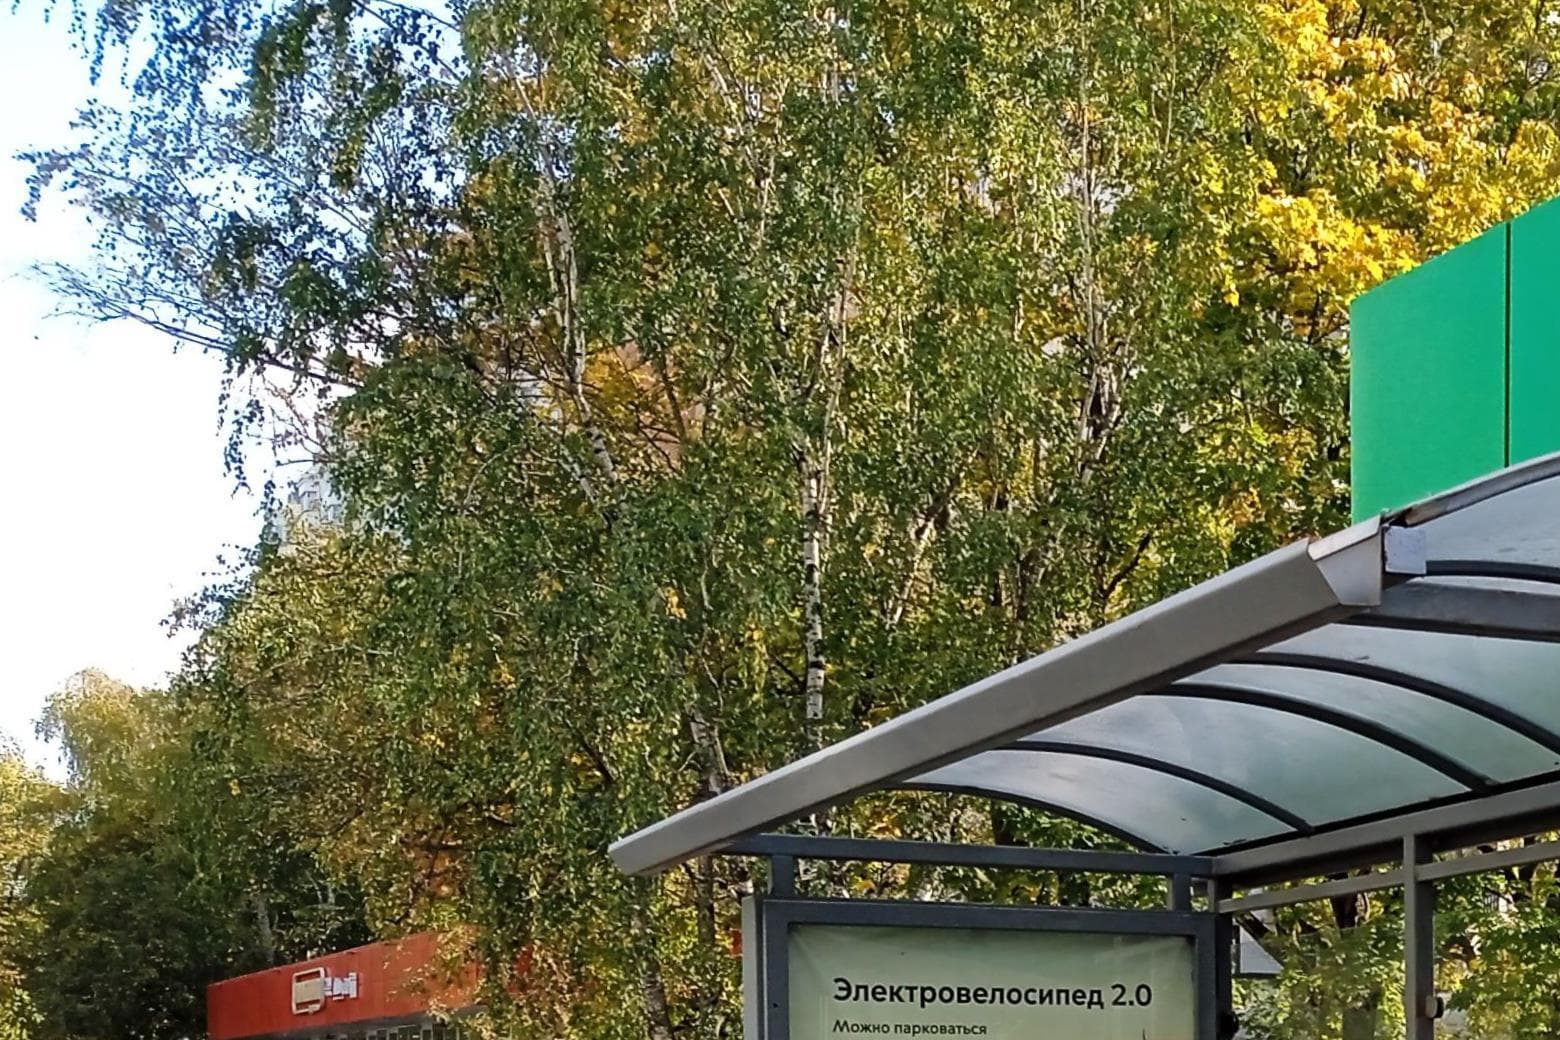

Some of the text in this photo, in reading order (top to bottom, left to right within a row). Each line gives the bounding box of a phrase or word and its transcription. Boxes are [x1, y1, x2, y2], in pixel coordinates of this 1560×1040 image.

[833, 977, 1152, 1010] Электровелосипед 2.0
[832, 1019, 987, 1038] Можно парковаться
